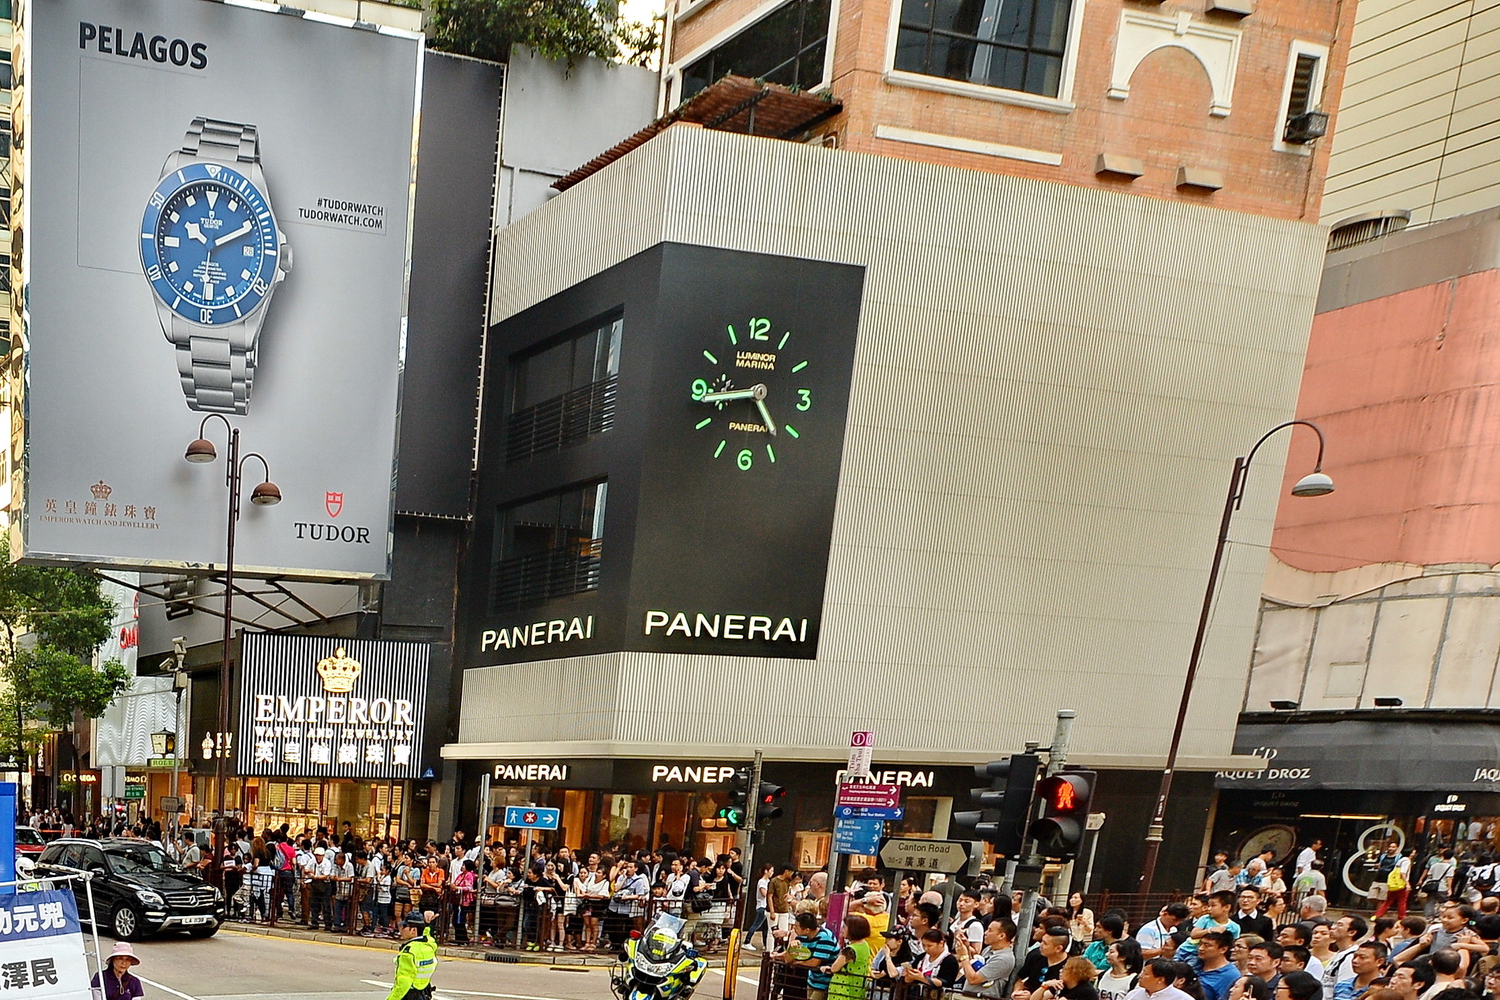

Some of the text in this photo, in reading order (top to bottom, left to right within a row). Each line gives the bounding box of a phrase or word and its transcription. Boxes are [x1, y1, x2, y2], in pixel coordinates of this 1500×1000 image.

[78, 21, 208, 71] PELAGOS
[317, 197, 384, 217] #TUDORWATCH
[200, 217, 223, 227] TUDOR
[298, 207, 383, 230] TUDORWATCH.COM
[749, 317, 770, 341] 12
[735, 359, 775, 371] MARINA
[736, 350, 776, 363] LUMINOR
[691, 378, 709, 400] 9
[795, 388, 812, 412] 3
[737, 449, 753, 471] 6
[75, 518, 101, 526] WATCH
[102, 519, 118, 527] AND
[119, 520, 160, 530] JEWELLERY
[294, 521, 371, 545] TUDOR
[480, 614, 594, 653] PANERAI
[645, 609, 808, 643] PANERAI
[254, 694, 414, 726] EMPEROR
[254, 726, 414, 741] WATCH AND JEWELLERY
[494, 764, 568, 781] PANERAI
[652, 765, 736, 784] PANER
[1215, 768, 1311, 780] AQUET DROZ
[898, 842, 950, 853] Canton Road
[905, 857, 939, 868] 廣東道
